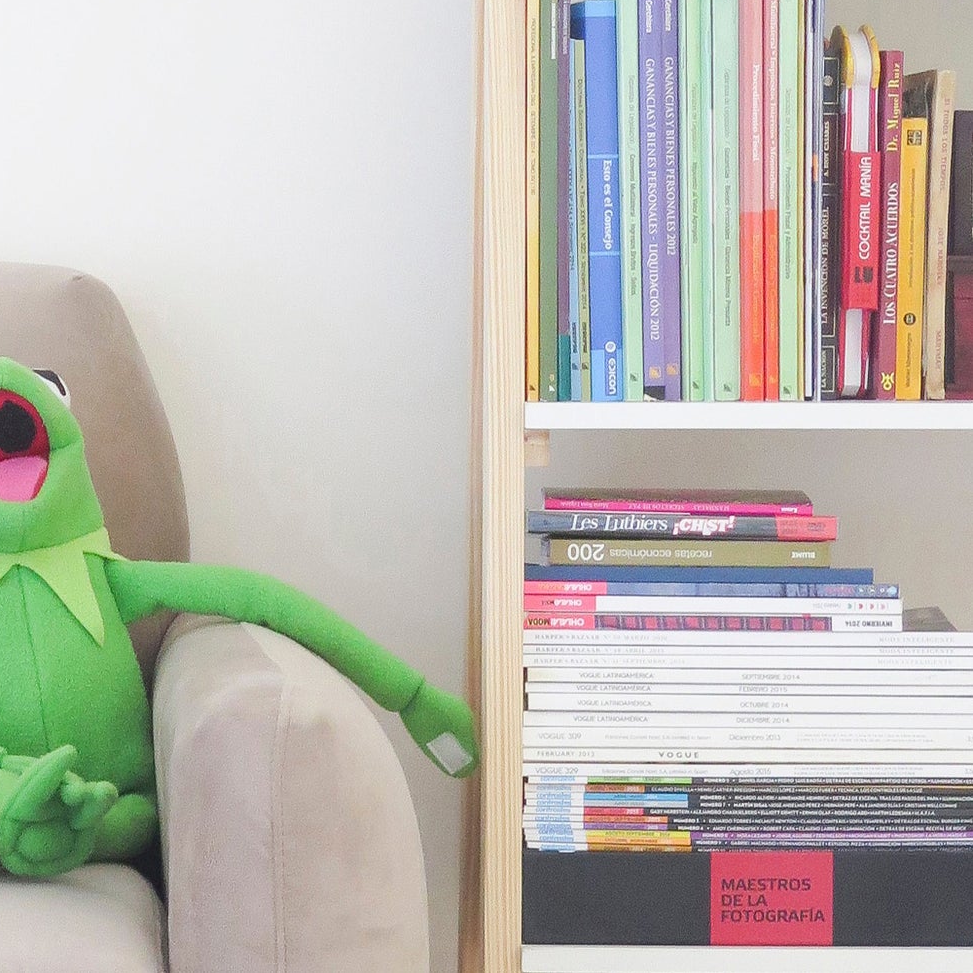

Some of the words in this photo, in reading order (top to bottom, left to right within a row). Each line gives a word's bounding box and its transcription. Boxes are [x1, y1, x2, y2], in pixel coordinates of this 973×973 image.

[645, 59, 656, 120] GANANCIAS
[665, 57, 674, 117] GANANCIAS
[769, 58, 777, 99] Impuestos
[888, 63, 899, 88] Ruiz
[753, 64, 762, 132] Procedimiento
[887, 93, 900, 129] Miguel
[646, 131, 657, 167] BIENES
[665, 131, 675, 166] BIENES
[753, 135, 762, 161] Fiscal
[887, 135, 899, 152] Dr.
[603, 160, 612, 180] Esto
[859, 157, 871, 197] MANÍA
[604, 184, 611, 195] es
[604, 198, 614, 207] el
[647, 171, 658, 233] PERSONALES
[666, 168, 676, 231] PERSONALES
[602, 210, 614, 249] Consejo
[885, 183, 898, 246] ACUERDOS
[667, 233, 676, 255] 2012
[859, 202, 870, 259] COCKTAIL
[648, 243, 661, 316] LIQUIDACIÓN
[884, 249, 896, 297] CUATRO
[883, 303, 895, 324] LOS
[650, 318, 659, 340] 2012
[571, 514, 598, 530] Les
[603, 515, 667, 531] Luthiers
[568, 543, 604, 561] 200
[675, 550, 712, 558] recetas
[730, 768, 755, 776] Agosto
[721, 879, 811, 891] MAESTROS
[721, 895, 743, 906] DE
[748, 895, 767, 906] LA
[721, 908, 824, 923] FOTOGRAFÍA
